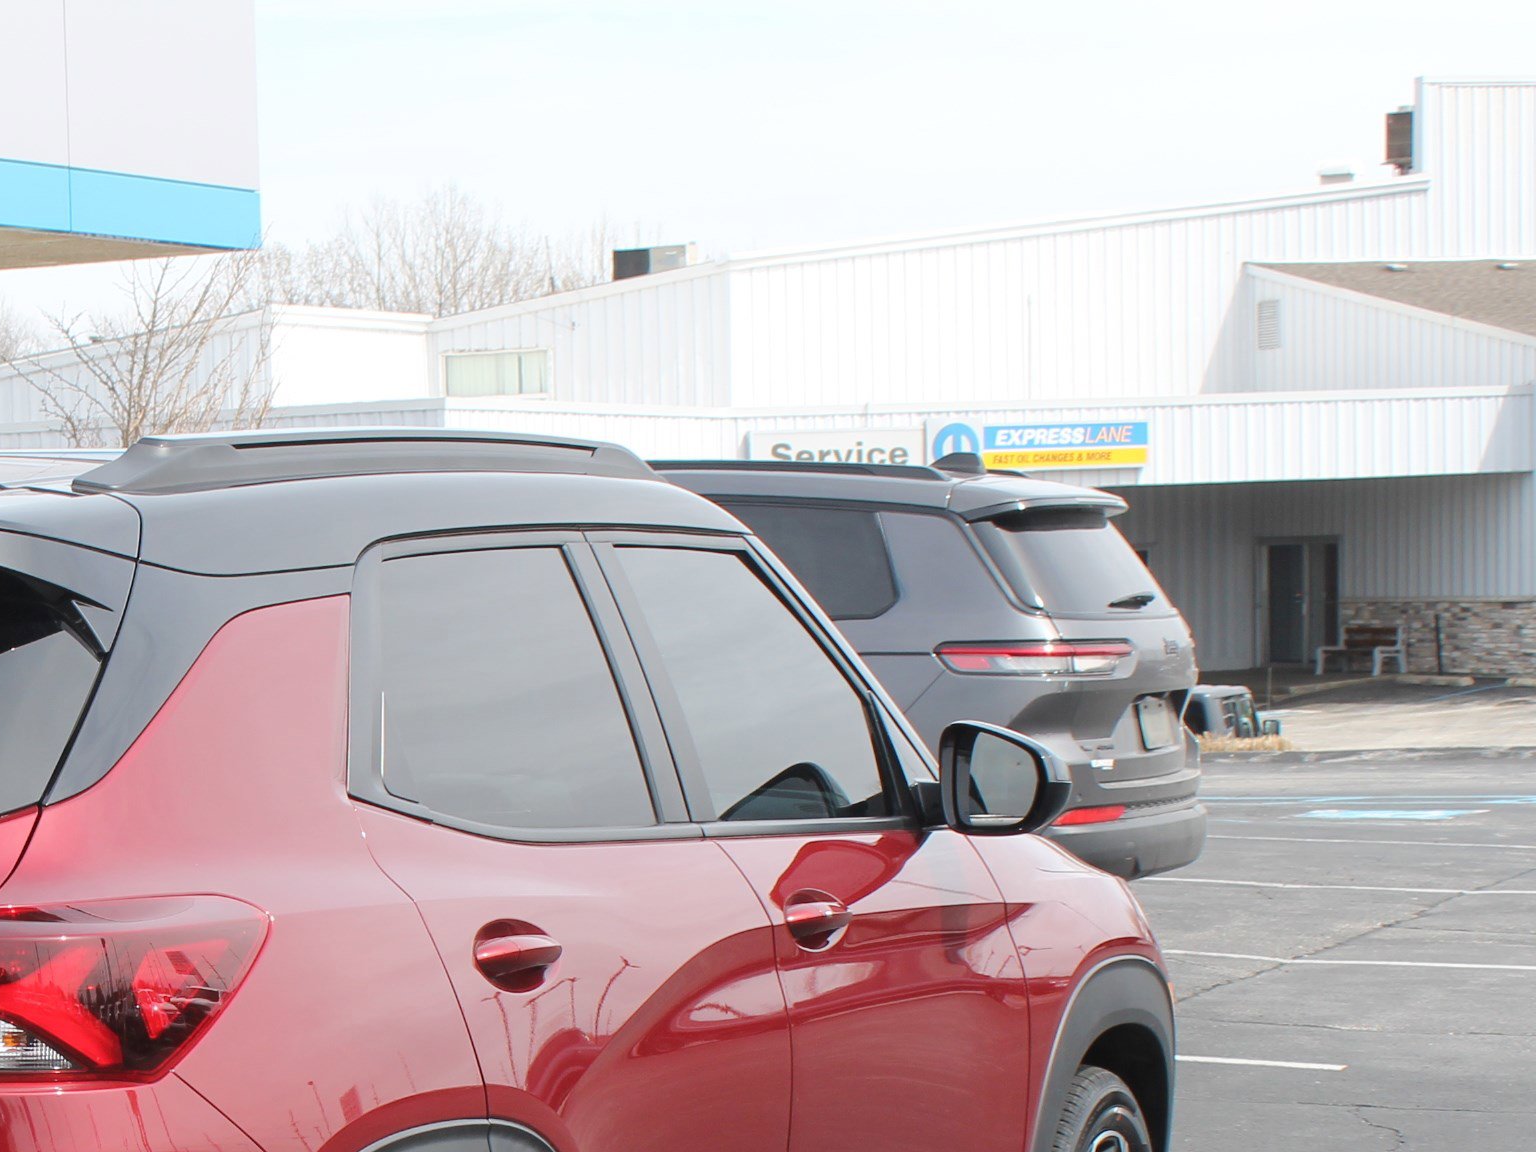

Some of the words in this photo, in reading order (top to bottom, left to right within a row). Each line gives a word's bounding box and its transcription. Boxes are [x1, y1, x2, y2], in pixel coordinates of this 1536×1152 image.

[771, 441, 909, 465] Service
[993, 454, 1014, 464] FAST
[1016, 454, 1029, 464] OIL
[1033, 452, 1074, 463] CHANGES
[1085, 451, 1112, 461] MORE
